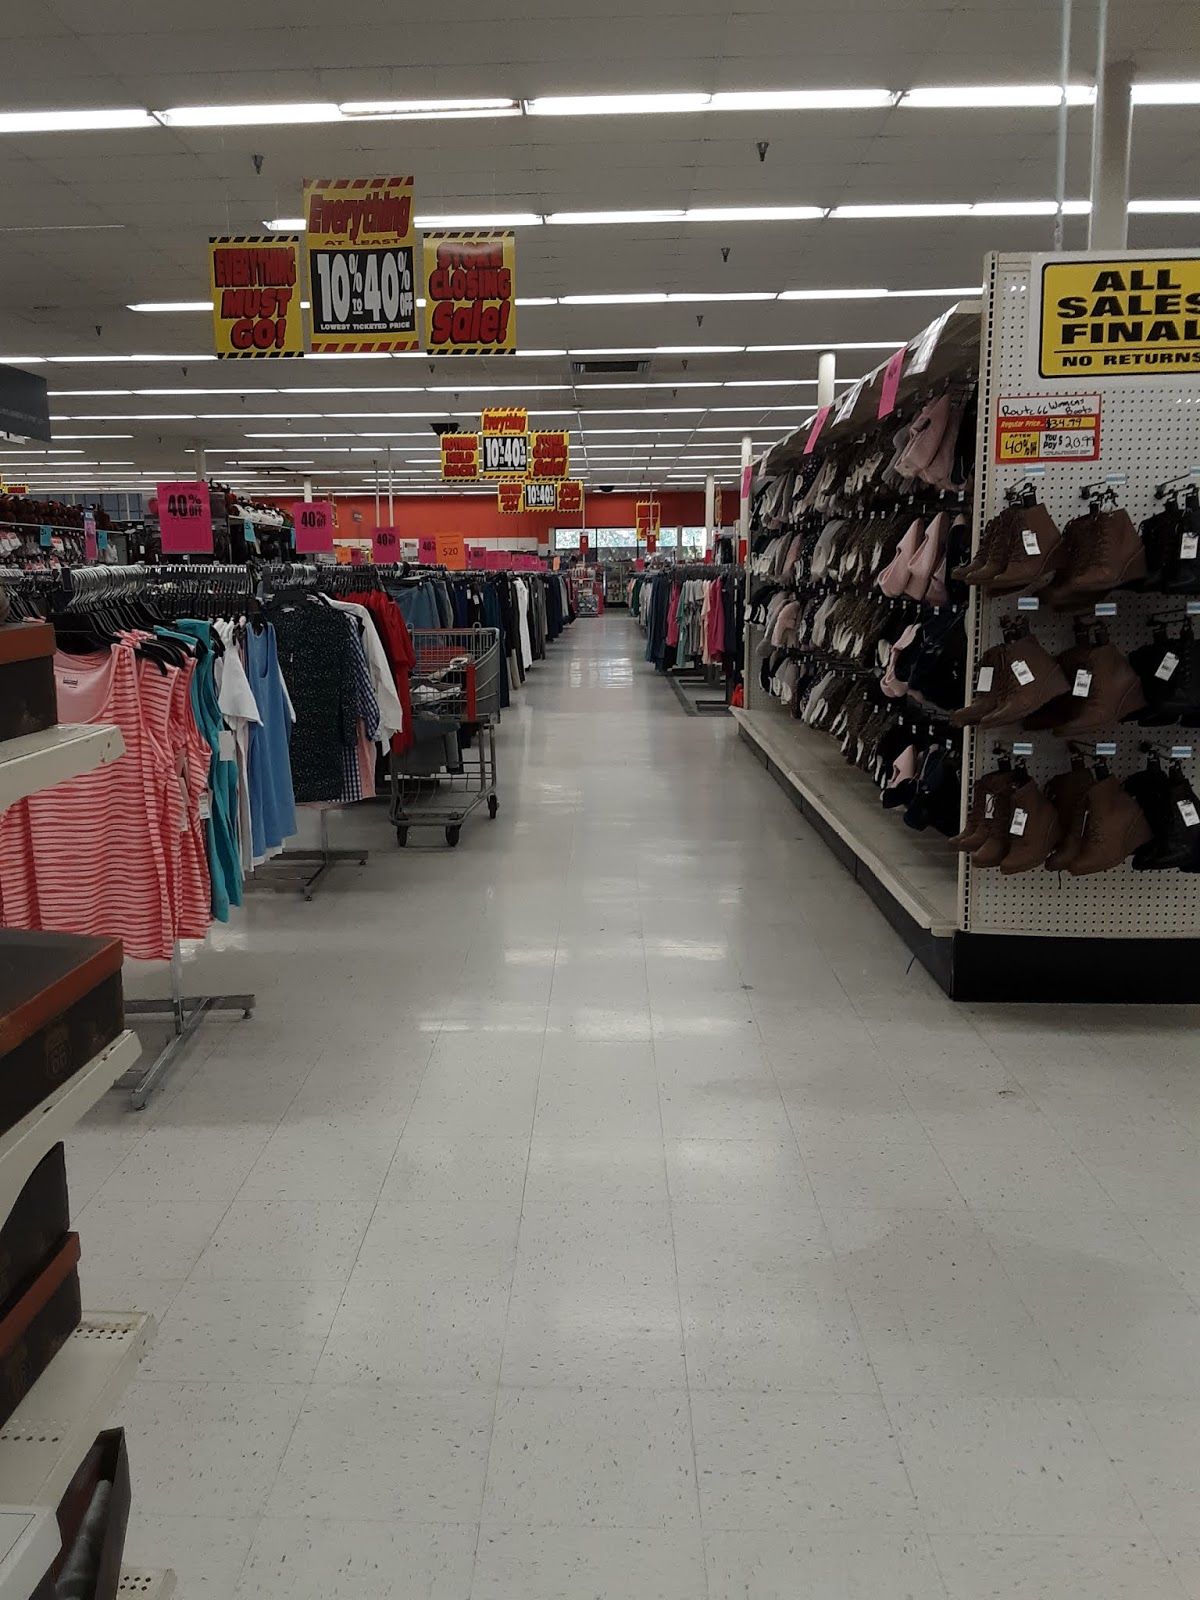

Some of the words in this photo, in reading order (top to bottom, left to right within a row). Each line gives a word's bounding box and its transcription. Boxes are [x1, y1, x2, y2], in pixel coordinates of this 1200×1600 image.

[309, 191, 411, 240] Everything
[350, 238, 401, 246] LEAST
[213, 247, 297, 288] EVERYTHING
[429, 268, 511, 301] CLOSING
[1092, 269, 1181, 292] ALL
[221, 288, 292, 319] MUST
[400, 292, 413, 318] OFF
[231, 319, 287, 349] GO!
[320, 323, 351, 331] LOWEST
[389, 321, 410, 329] PRICE
[430, 301, 511, 344] Sale!
[1062, 320, 1200, 344] FINAL
[1062, 355, 1092, 367] NO
[1103, 352, 1200, 366] RETURNS
[1065, 406, 1092, 415] Boots
[1045, 433, 1057, 441] YOU
[189, 505, 202, 517] OFF
[442, 547, 458, 556] $20
